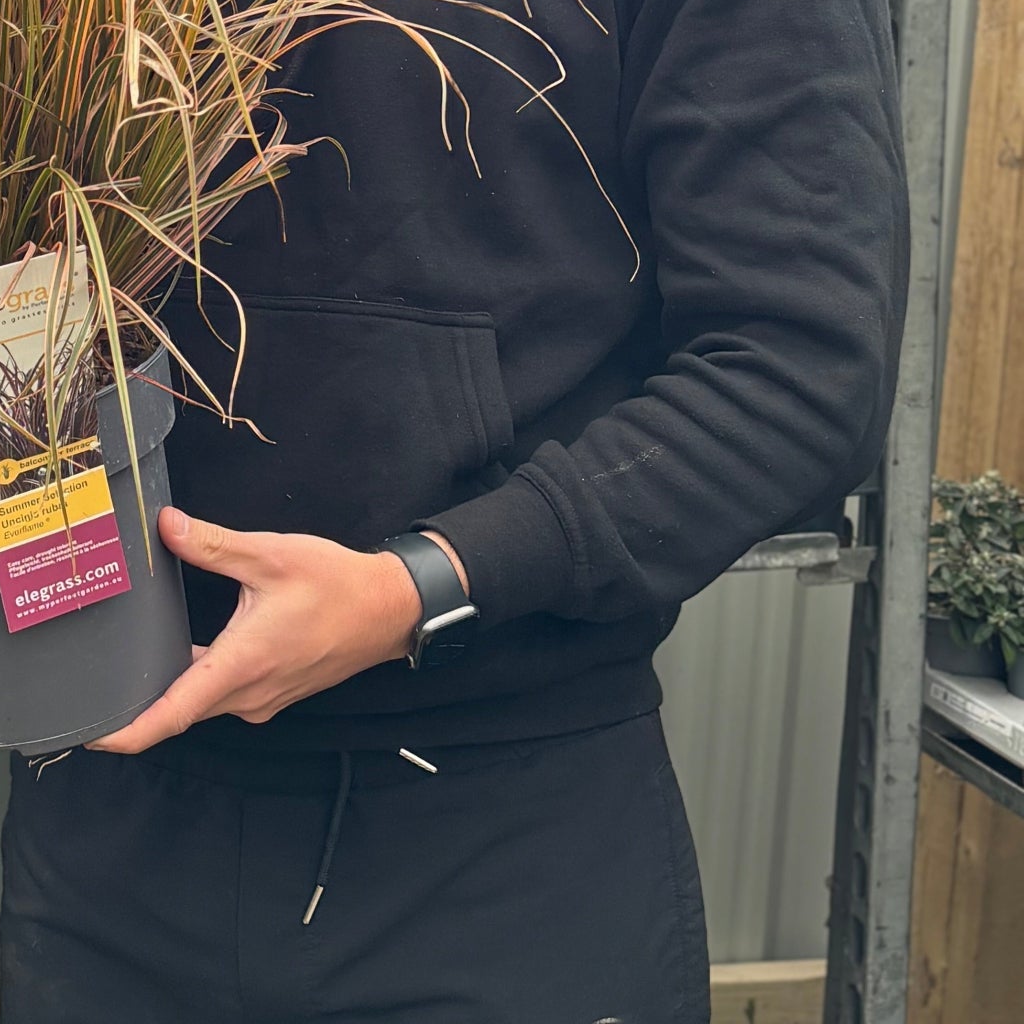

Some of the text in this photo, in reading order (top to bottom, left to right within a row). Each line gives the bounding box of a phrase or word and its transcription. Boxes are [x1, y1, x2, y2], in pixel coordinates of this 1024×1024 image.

[19, 455, 53, 469] balcon
[0, 480, 88, 517] Summer Selction
[16, 561, 119, 607] elegrass.com
[16, 576, 122, 618] www.myperfectgarden.eu
